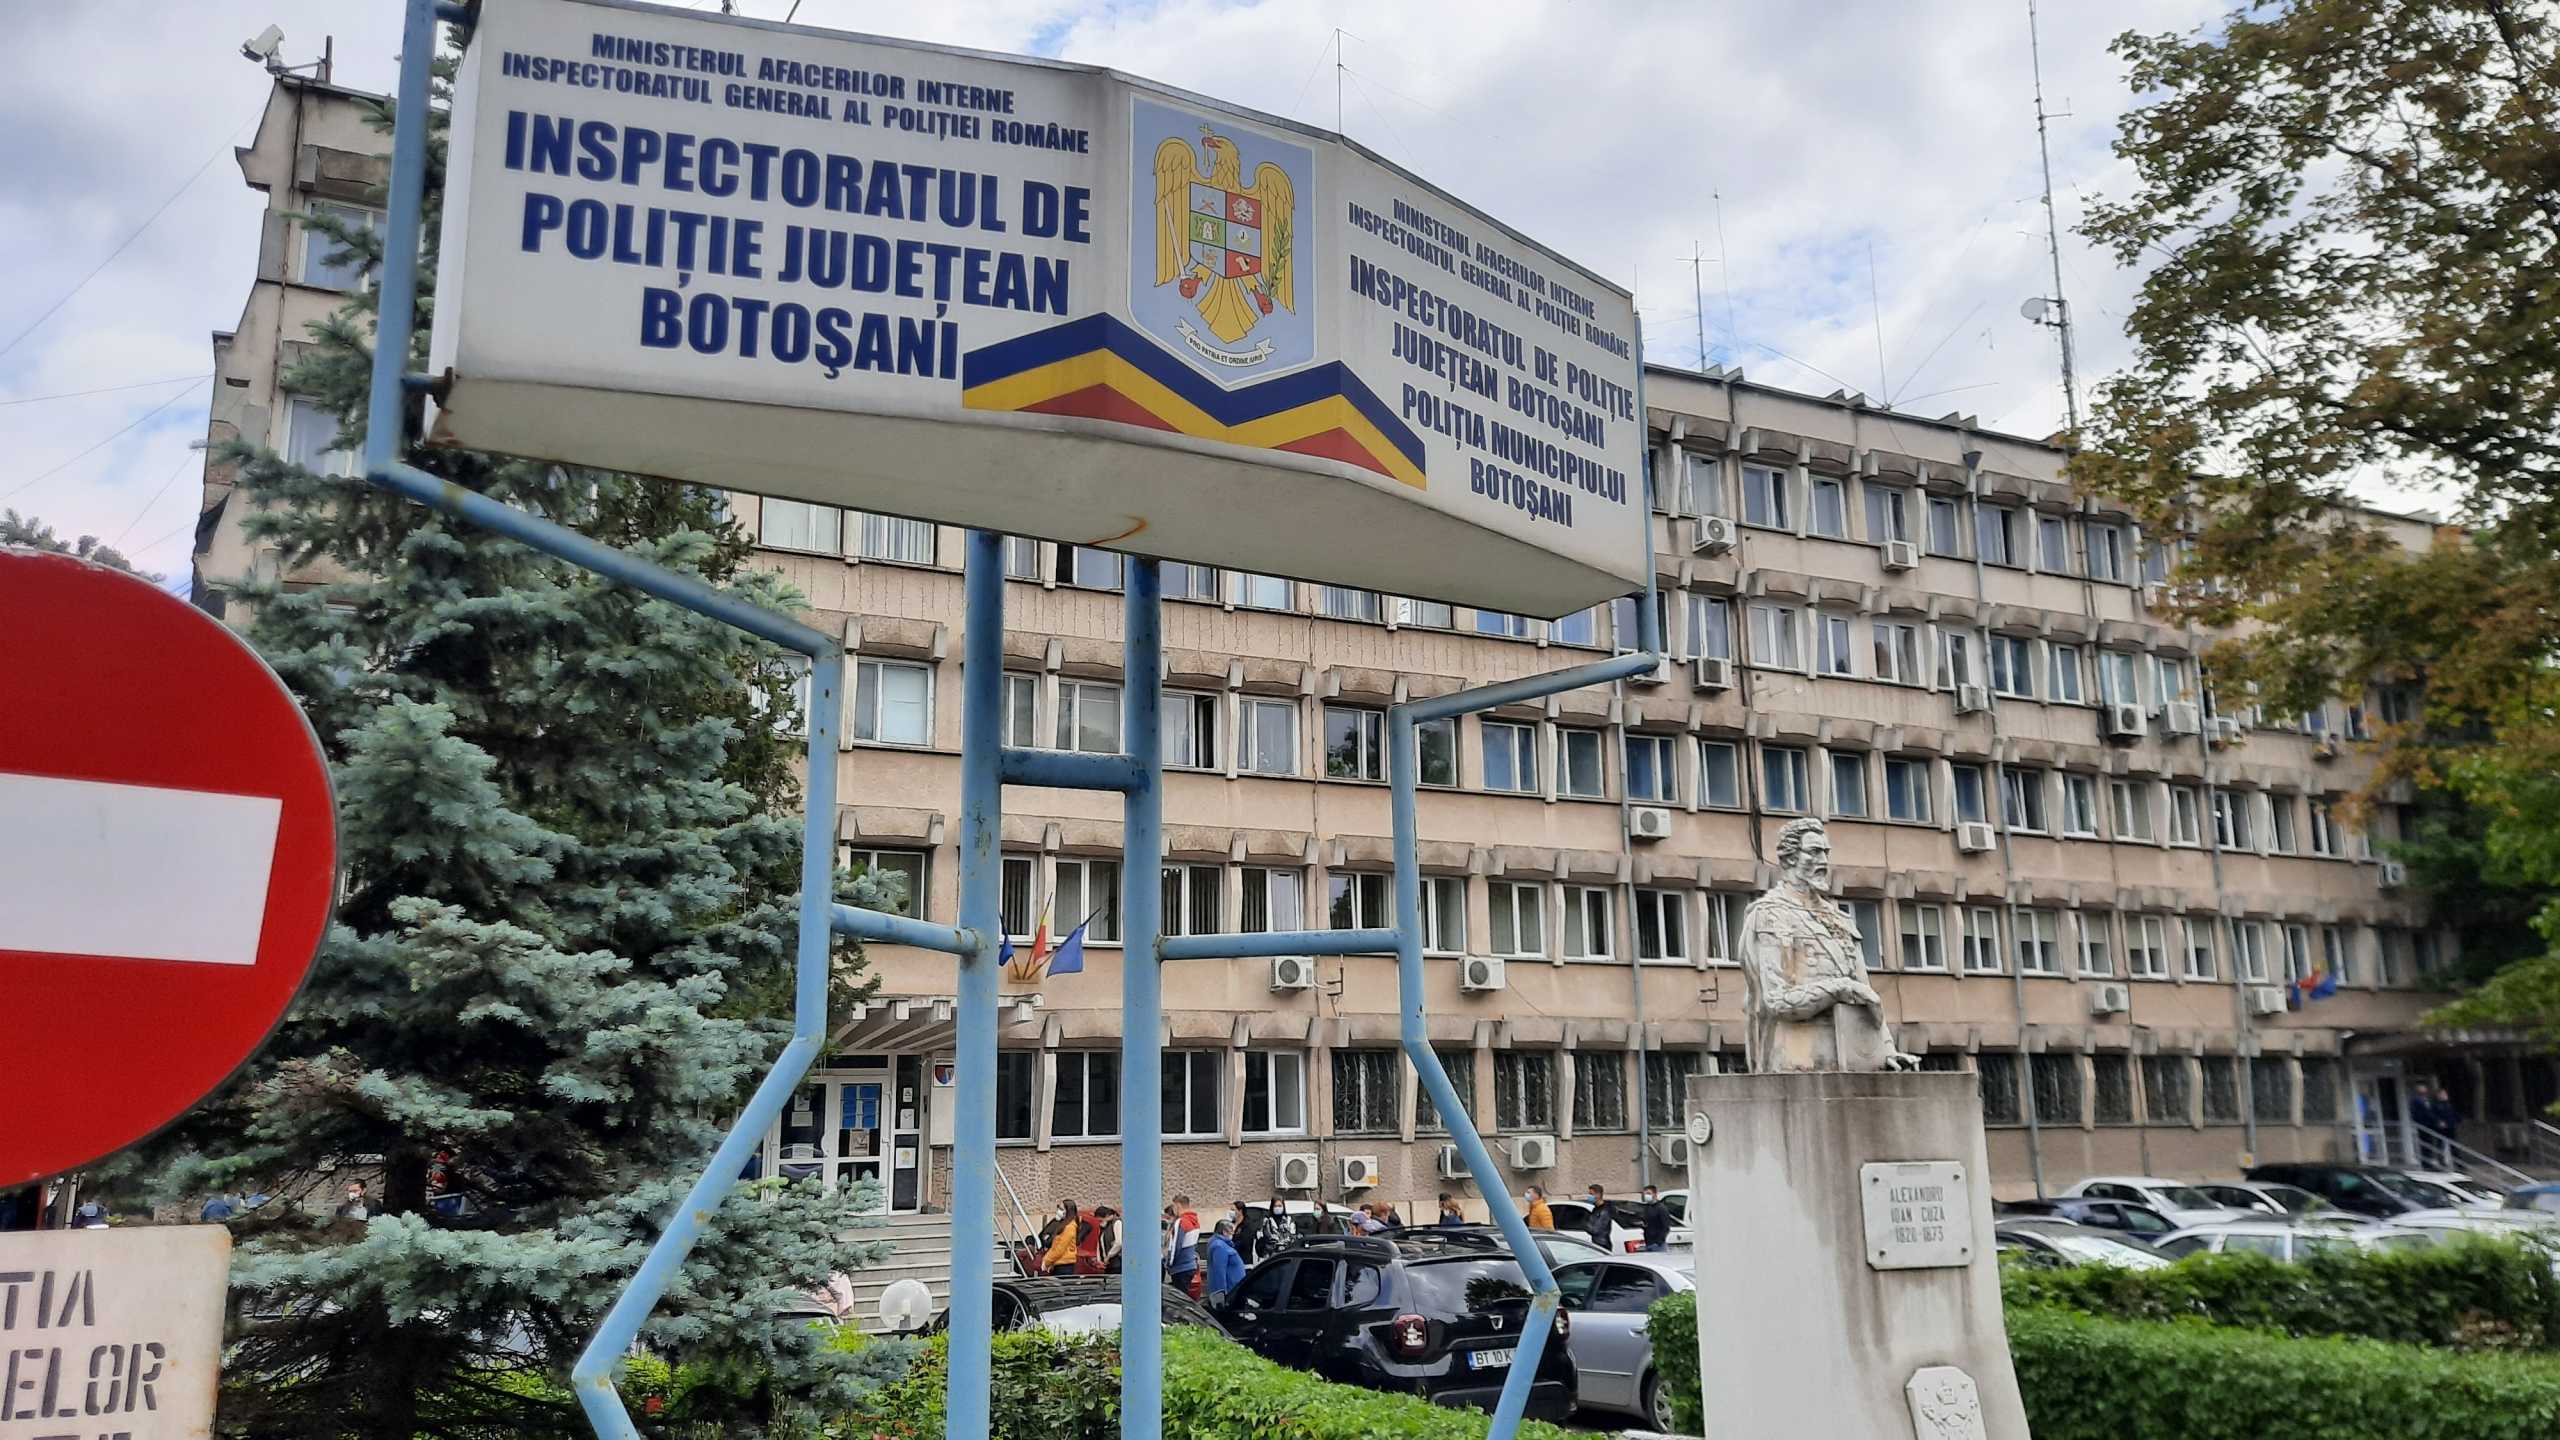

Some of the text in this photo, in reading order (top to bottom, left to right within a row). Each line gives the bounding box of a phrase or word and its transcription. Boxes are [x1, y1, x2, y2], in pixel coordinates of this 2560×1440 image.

[502, 51, 1089, 154] INSPECTORATUL GENERAL AL POLIȚIEI ROMÂNE
[592, 33, 1015, 115] MINISTERUL AFACERILOR INTERNE
[505, 110, 1092, 244] INSPECTORATUL DE
[522, 192, 1070, 319] POLIȚIE JUDEȚEAN
[1348, 201, 1630, 361] INSPECTORATUL GENERAL AL POLIȚIEI ROMÂNE
[1393, 198, 1596, 321] MINISTERUL AFACERILOR INTERNE
[1350, 253, 1635, 423] INSPECTORATUL DE POLIȚIE
[1392, 321, 1498, 402] JUDEȚEAN
[1402, 382, 1627, 505] POLIȚIA MUNICIPIULUI
[1920, 1206, 1945, 1222] CUZA
[1, 1342, 166, 1421] ELOR
[1475, 1352, 1489, 1365] BT
